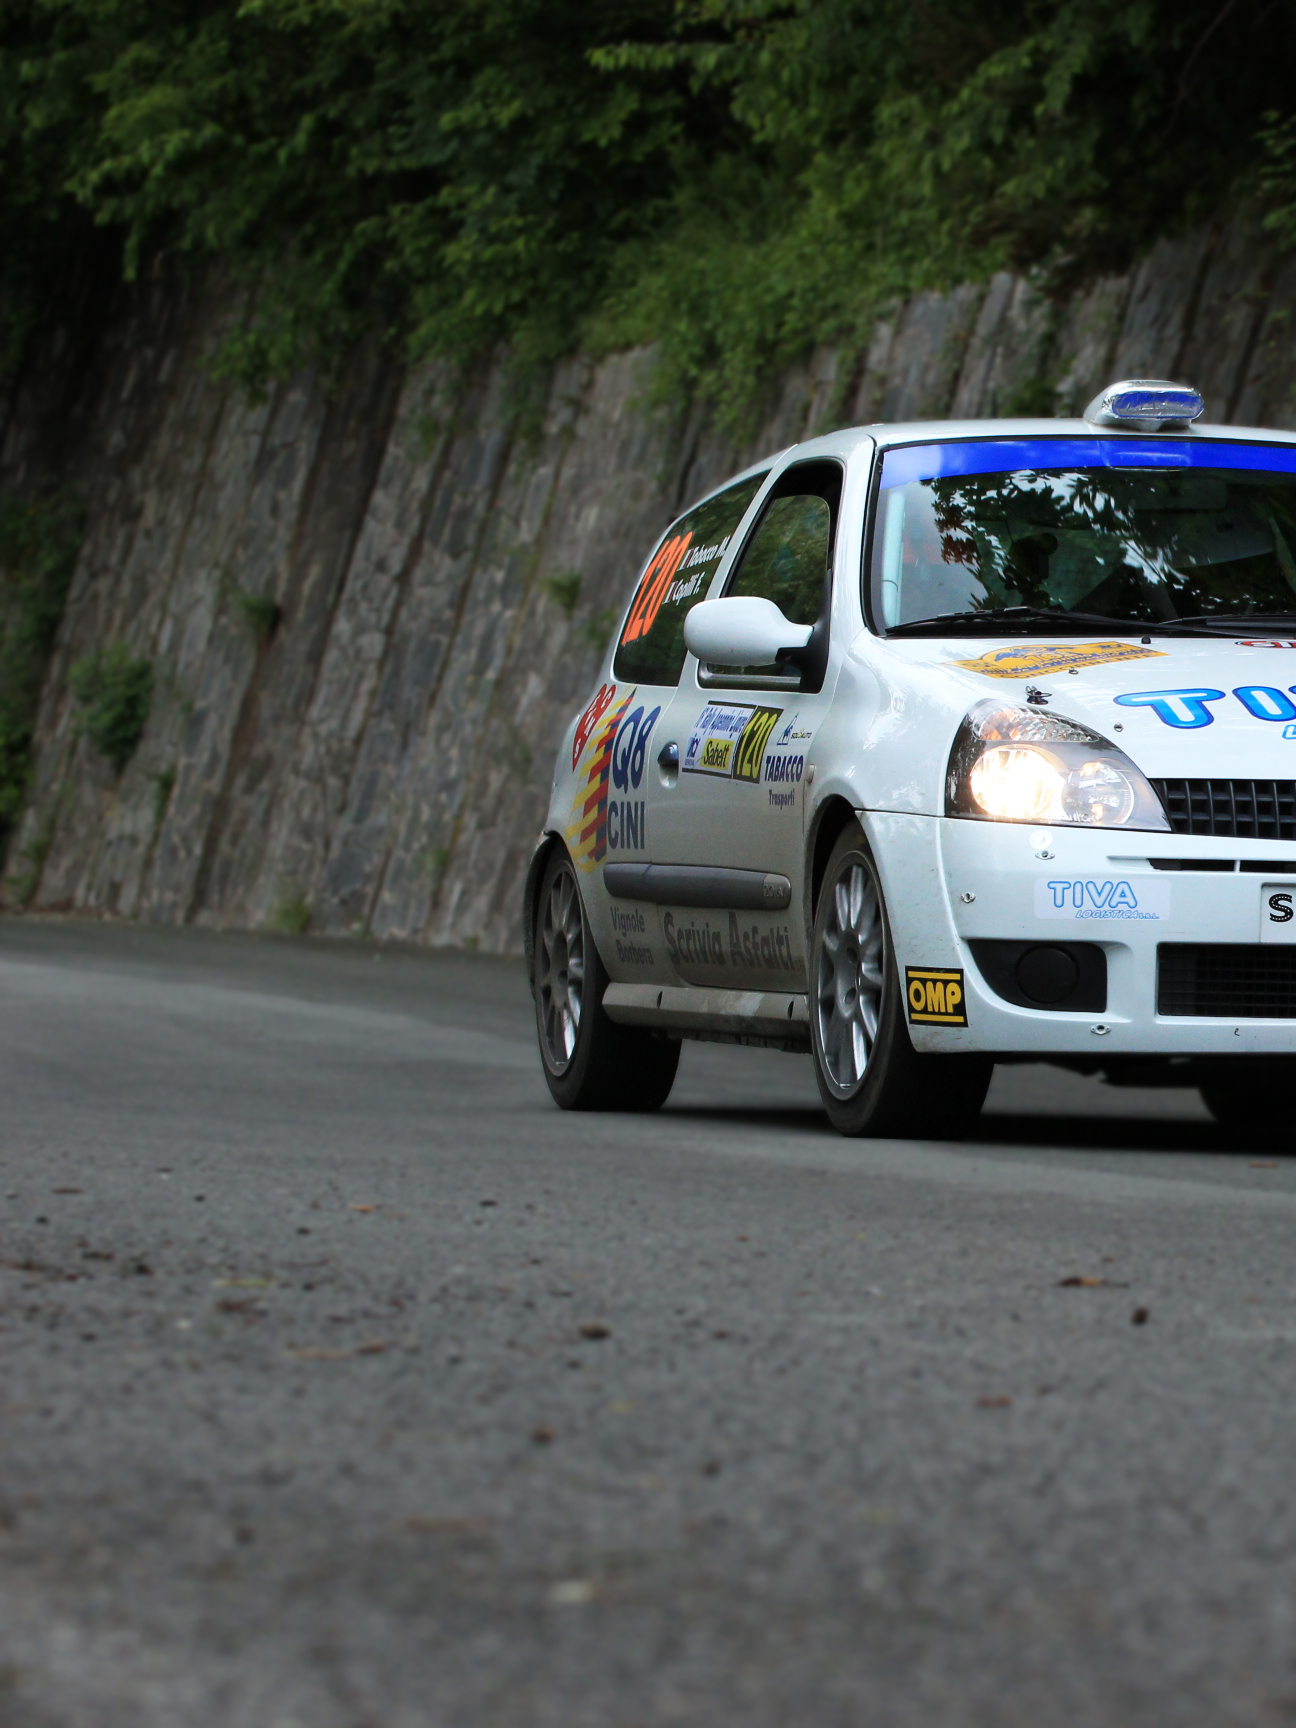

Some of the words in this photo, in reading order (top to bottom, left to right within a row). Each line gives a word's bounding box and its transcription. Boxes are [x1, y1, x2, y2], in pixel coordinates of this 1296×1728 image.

[621, 531, 694, 646] 120
[613, 705, 661, 793] Q8
[737, 711, 778, 779] 120
[764, 755, 804, 782] TABACCO
[607, 801, 645, 849] CINI
[1047, 881, 1138, 909] TIVA
[1075, 910, 1139, 920] LOGISTICA
[610, 907, 645, 938] Vignole
[664, 911, 726, 966] Scrivia
[728, 910, 795, 971] Asfalti
[909, 980, 962, 1013] OMP
